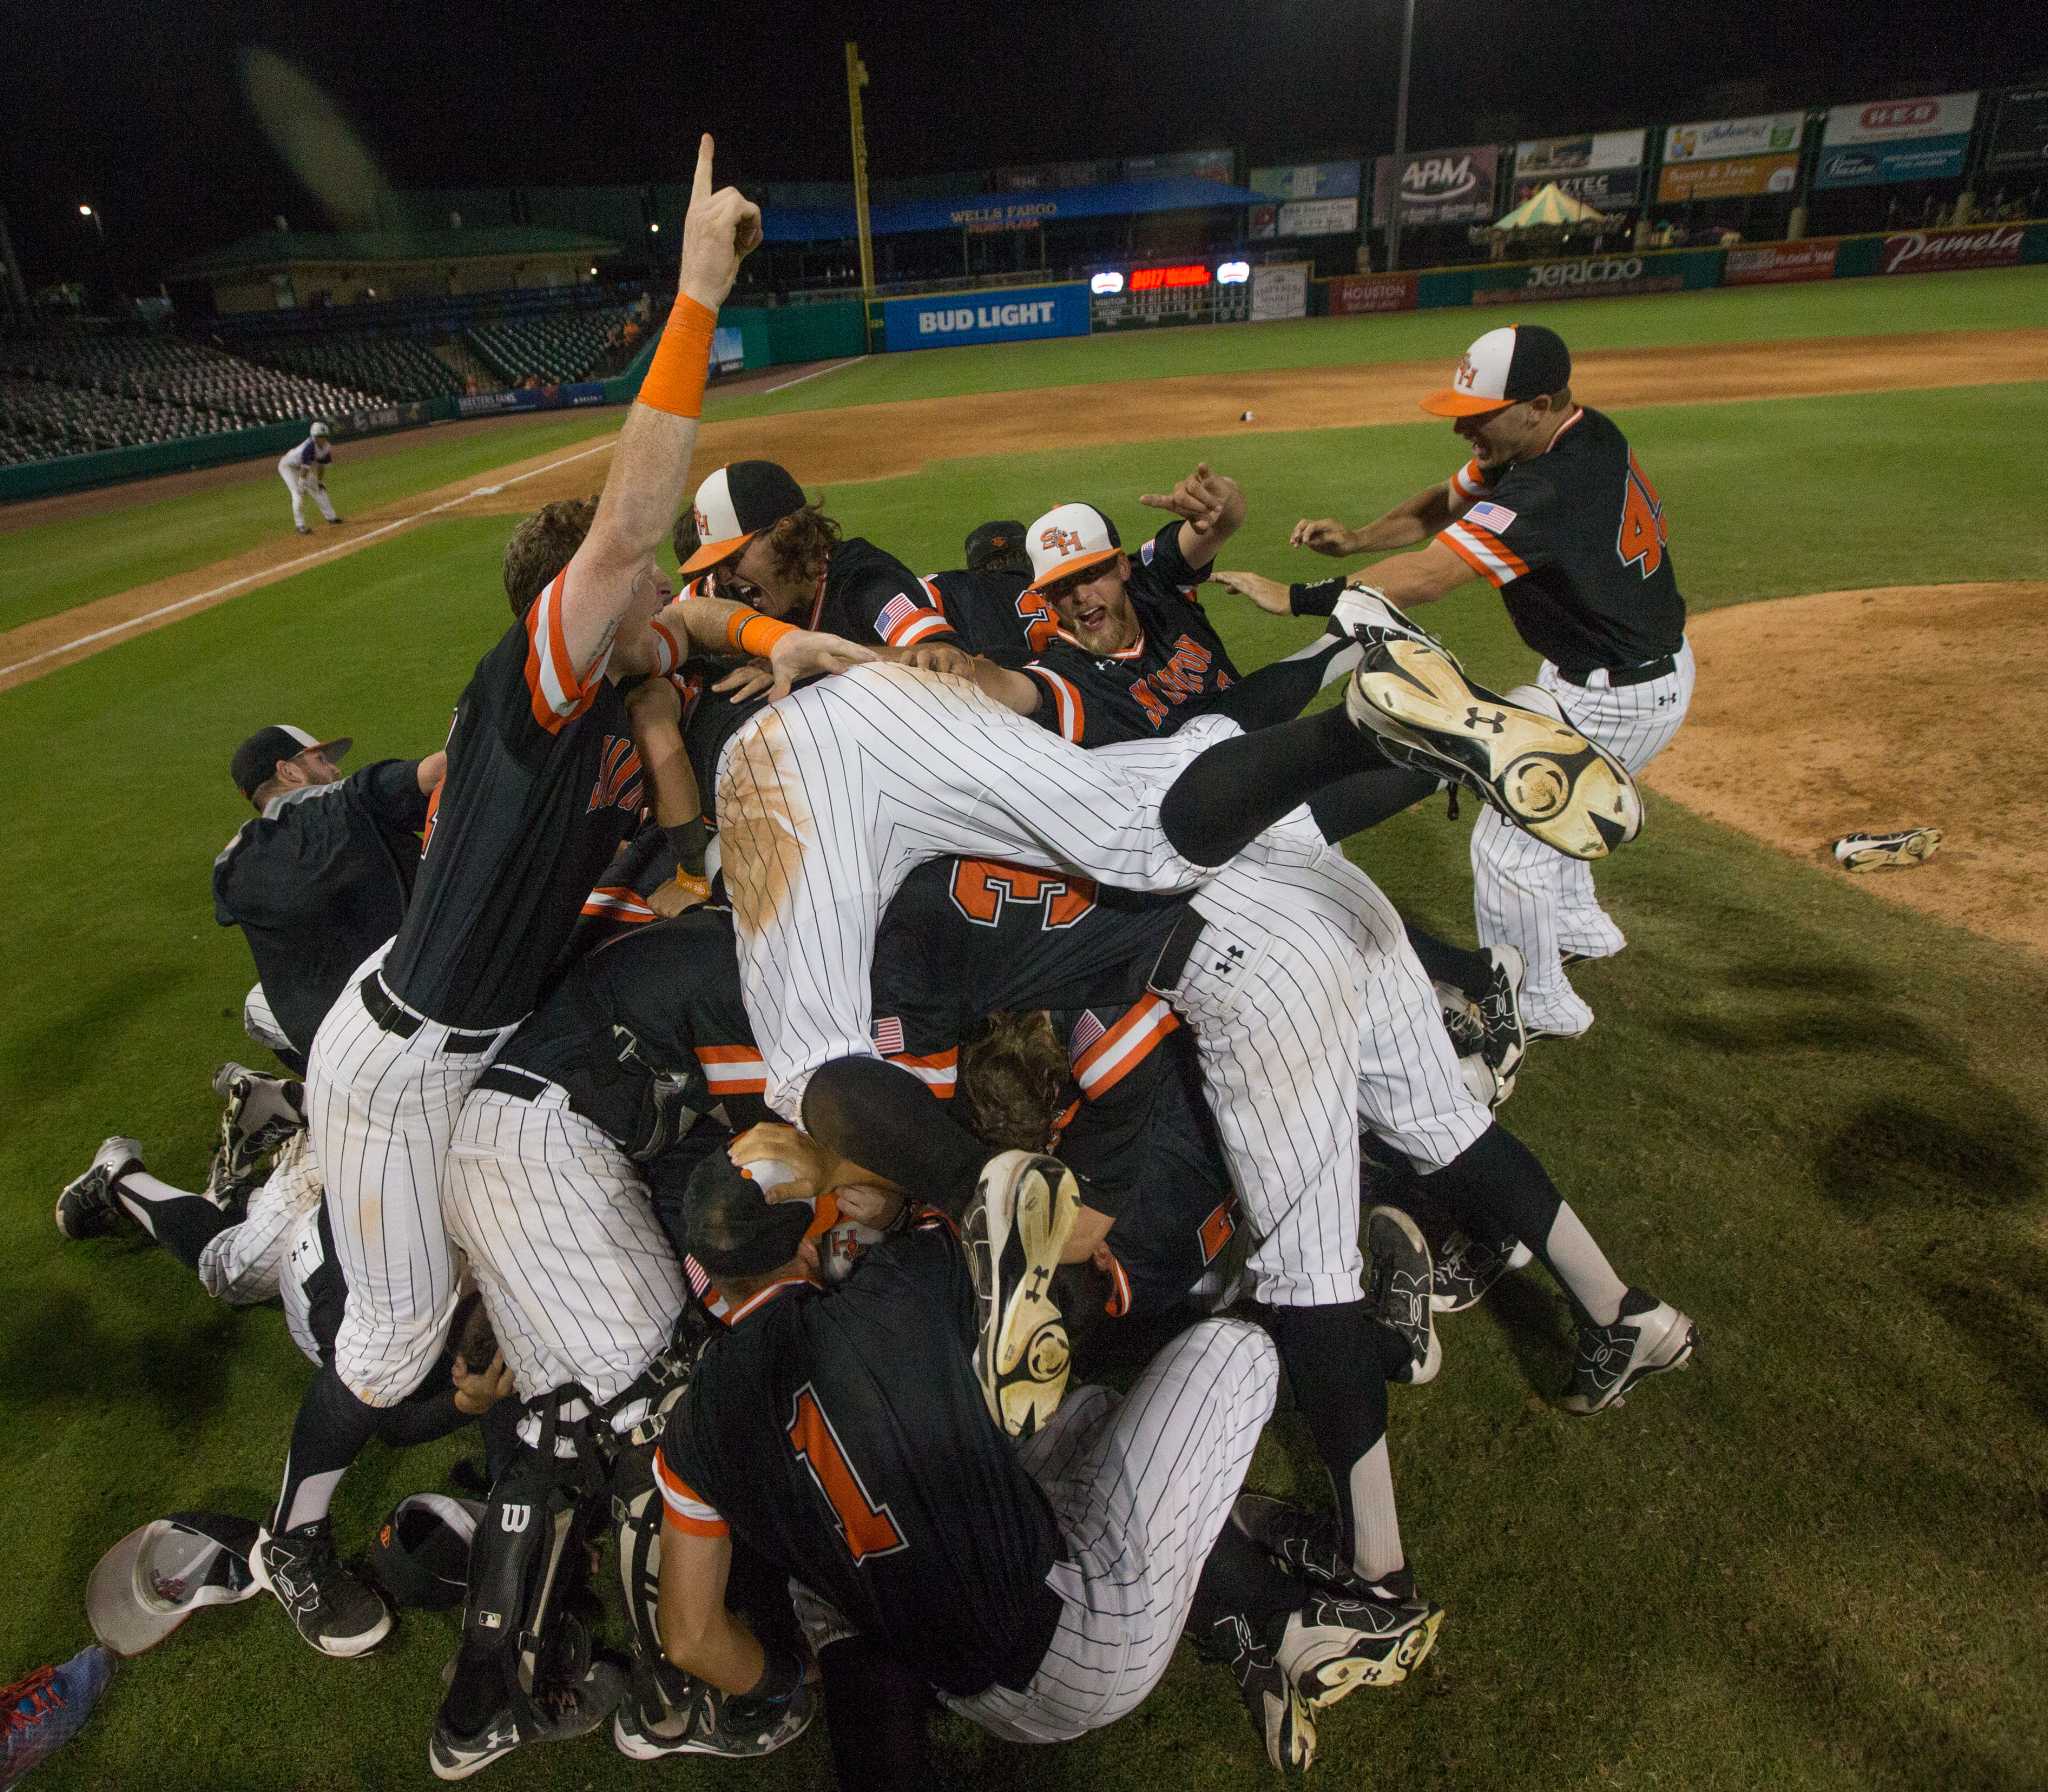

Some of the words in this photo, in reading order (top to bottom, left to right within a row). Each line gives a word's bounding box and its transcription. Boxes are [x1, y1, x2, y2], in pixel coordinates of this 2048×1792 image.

[1400, 156, 1471, 189] ARM
[950, 208, 1002, 224] WELLS
[1007, 202, 1057, 217] FARGO
[1884, 225, 2024, 273] Pamela
[1343, 285, 1406, 299] HOUSTON
[919, 309, 975, 334] BUD
[978, 301, 1055, 329] LIGHT
[1040, 527, 1082, 556] SH
[786, 1380, 910, 1567] 1
